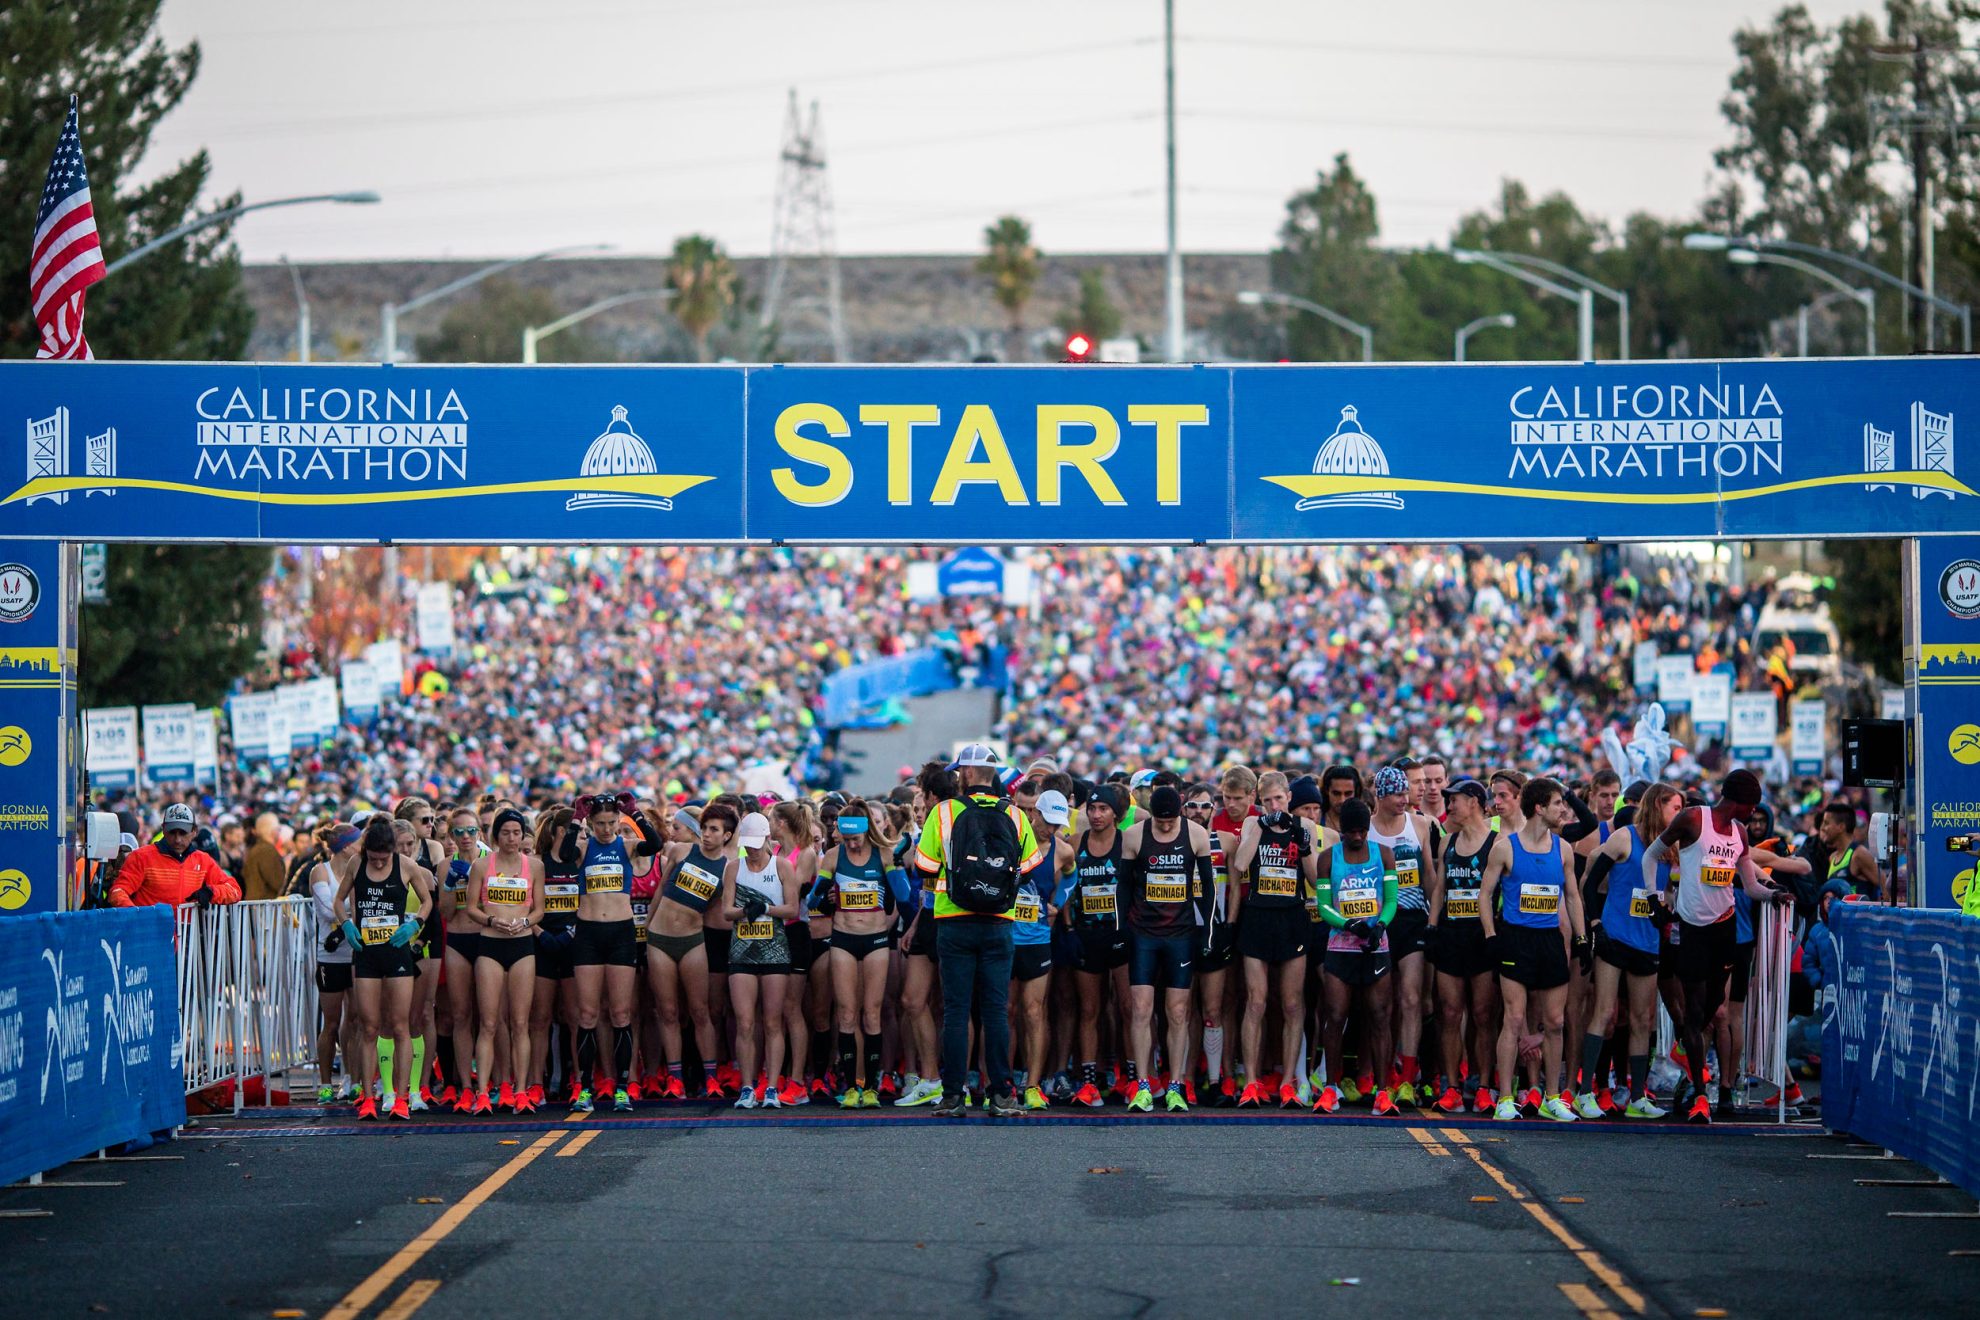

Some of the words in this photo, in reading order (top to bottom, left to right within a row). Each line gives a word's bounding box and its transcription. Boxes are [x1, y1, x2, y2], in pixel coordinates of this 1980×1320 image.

[195, 386, 469, 422] CALIFORNIA
[1510, 382, 1784, 419] CALIFORNIA
[199, 425, 466, 446] INTERNATIONAL
[1513, 420, 1781, 444] INTERNATIONAL
[771, 402, 1210, 507] START
[1508, 442, 1784, 479] MARATHON
[194, 447, 468, 481] MARATHON
[1956, 593, 1980, 601] USATF
[1259, 844, 1283, 856] WEST
[1709, 845, 1735, 859] ARMY
[1158, 854, 1184, 865] SLRC
[1260, 856, 1288, 866] VALLEY
[1081, 865, 1106, 877] rabbit
[1448, 867, 1471, 878] rabbit
[1706, 870, 1731, 882] LAGAT
[586, 875, 624, 890] MCWALTERS
[678, 872, 695, 889] VAN
[694, 881, 716, 898] BEEK
[1259, 879, 1297, 893] RICHARDS
[1340, 877, 1378, 890] ARMY
[367, 887, 384, 896] RUN
[487, 888, 527, 902] COSTELLO
[1147, 886, 1185, 899] ARCINIAGA
[357, 900, 377, 910] CAMP
[377, 901, 394, 911] FIRE
[545, 897, 576, 909] PEYTON
[846, 893, 874, 906] BRUCE
[1520, 896, 1558, 909] MCCLINTOCK
[362, 908, 387, 917] RELIEF
[1343, 901, 1374, 915] KOSGEI
[368, 928, 393, 941] BATES
[739, 924, 771, 936] CROUCH
